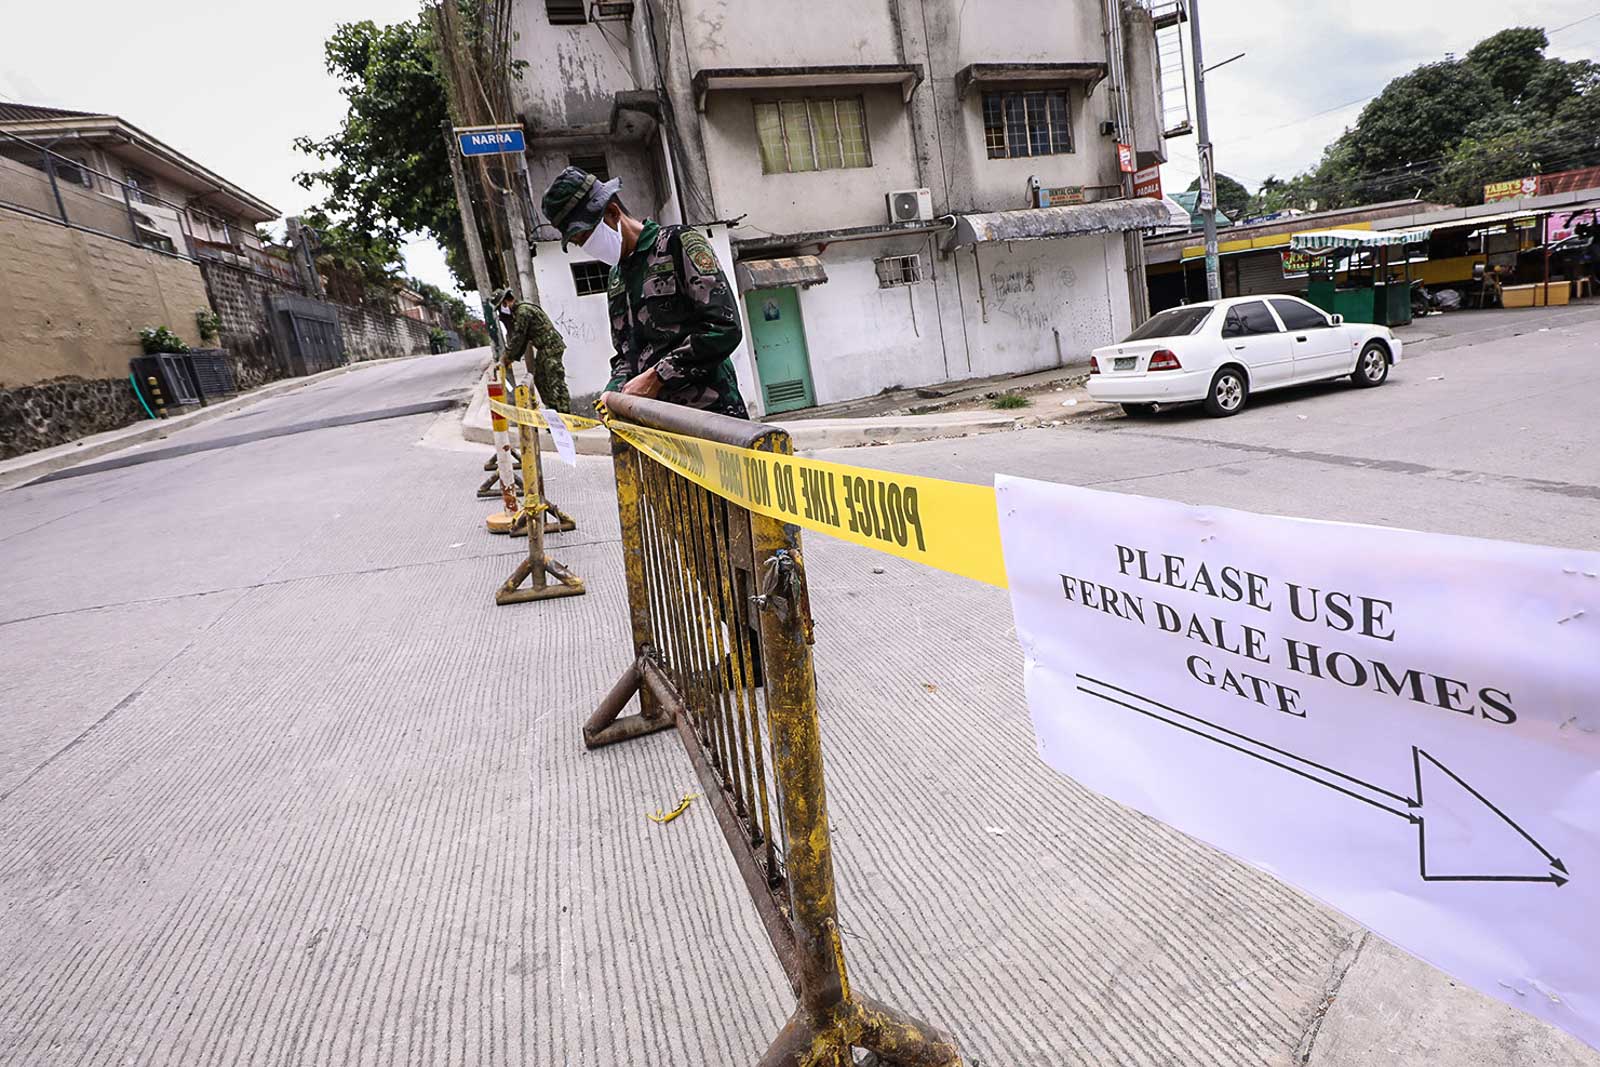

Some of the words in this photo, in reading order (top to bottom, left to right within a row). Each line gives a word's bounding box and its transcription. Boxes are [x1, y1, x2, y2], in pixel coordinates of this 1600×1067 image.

[471, 133, 512, 145] NARRA
[1114, 544, 1273, 612] PLEASE
[1285, 582, 1396, 642] USE
[1059, 573, 1146, 626] FERN
[1153, 601, 1271, 664] DALE
[1281, 637, 1518, 725] HOMES
[1186, 654, 1307, 719] GATE
